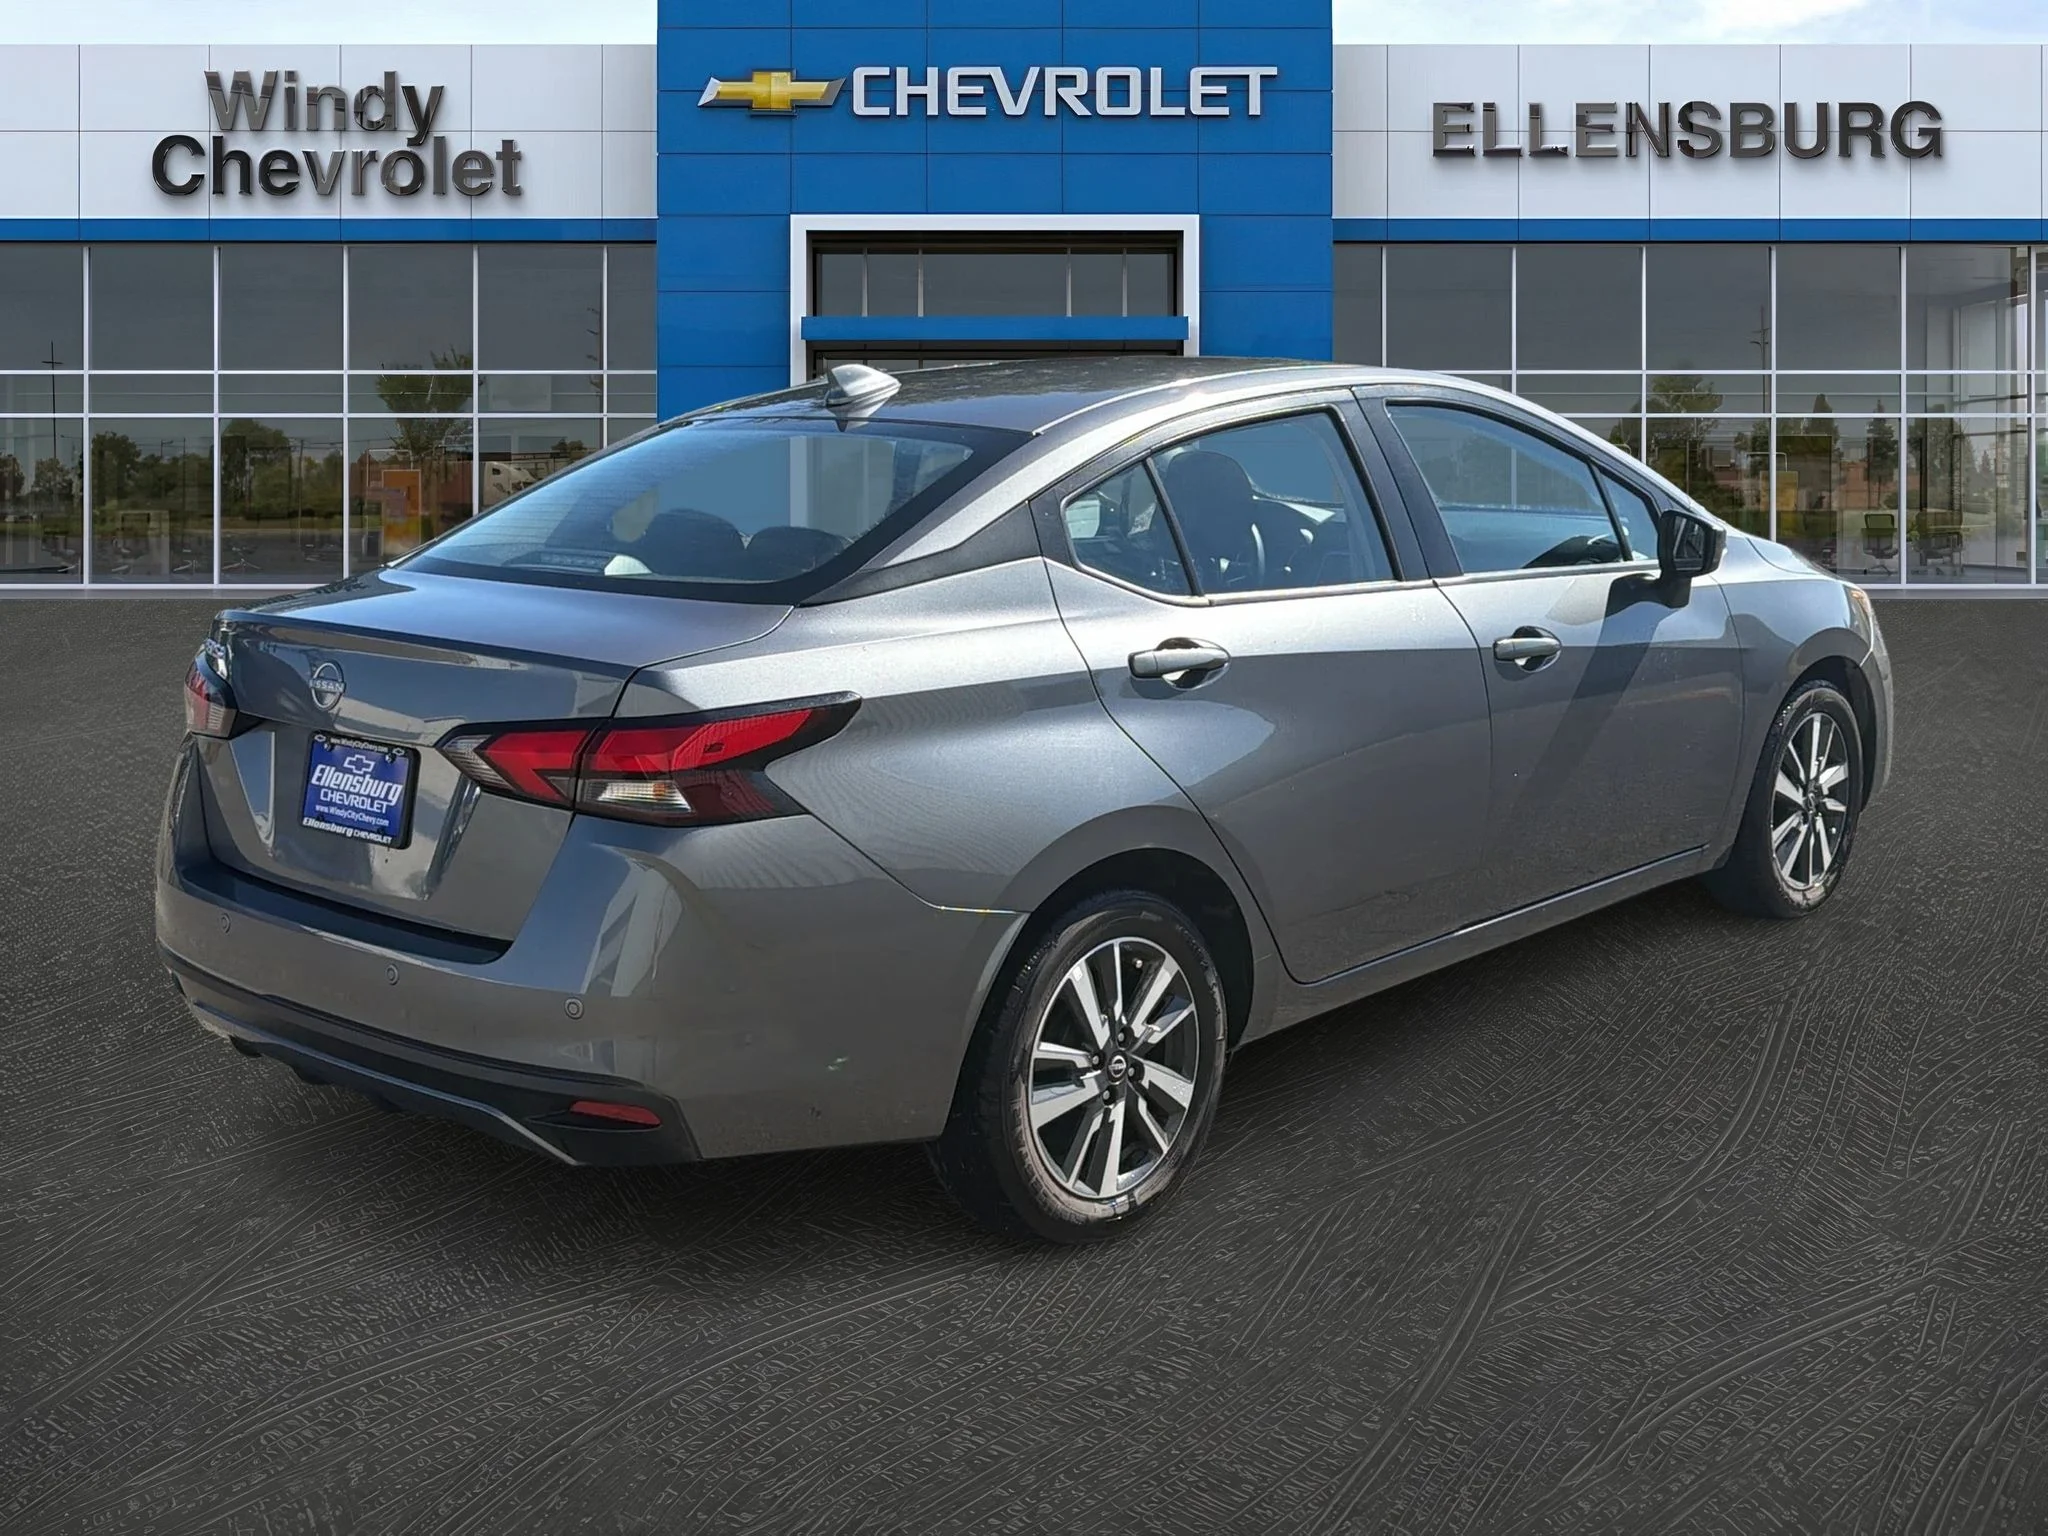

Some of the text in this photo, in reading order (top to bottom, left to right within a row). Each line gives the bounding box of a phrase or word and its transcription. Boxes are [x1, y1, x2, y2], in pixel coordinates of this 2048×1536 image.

[204, 70, 444, 146] Windy
[853, 66, 1278, 116] CHEVROLET
[1432, 100, 1943, 159] ELLENSBURG
[152, 134, 522, 196] Chevrolet
[311, 764, 403, 806] Ellensburg
[320, 788, 389, 814] CHEVROLET
[302, 817, 392, 844] Ellensburg CHEVROLET
[315, 804, 390, 826] www.WindyCityChevy.com
